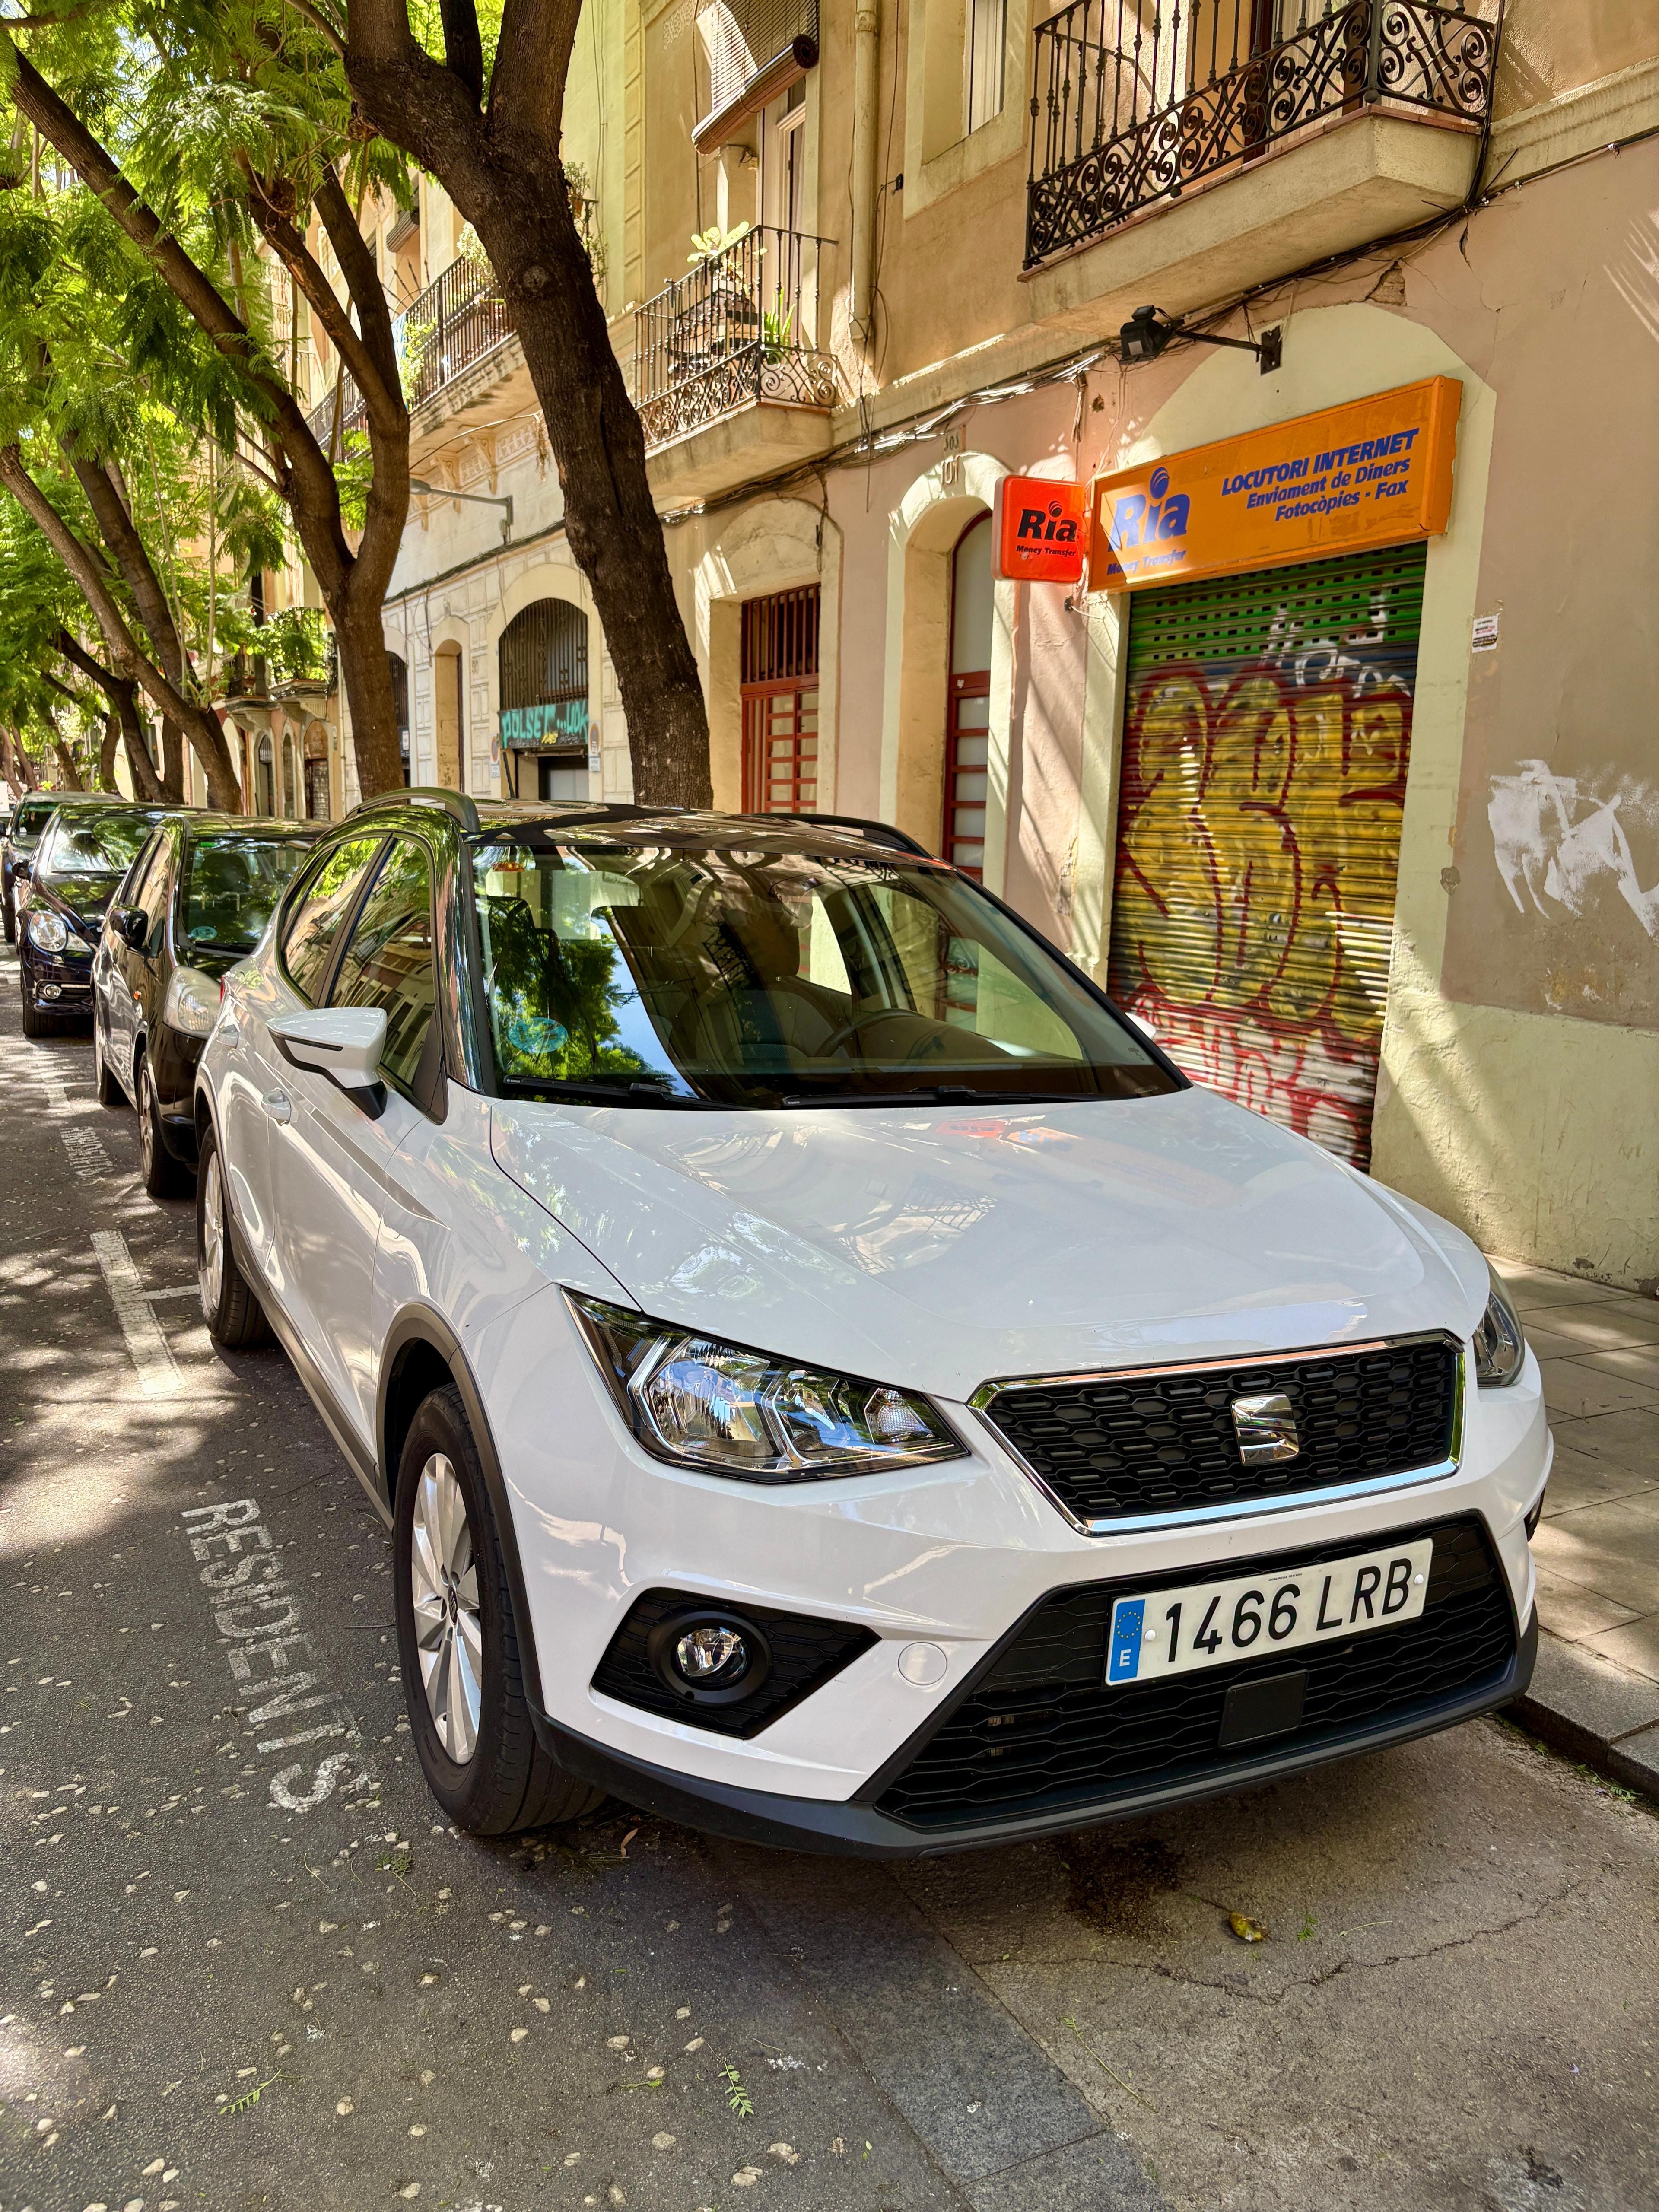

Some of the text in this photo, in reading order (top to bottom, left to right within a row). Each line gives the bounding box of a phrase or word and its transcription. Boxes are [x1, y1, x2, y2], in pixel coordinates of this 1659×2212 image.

[1221, 428, 1420, 496] LOCUTORI INTERNET
[1246, 458, 1411, 509] Enviament de Diners
[1017, 500, 1077, 542] Ria
[1108, 467, 1190, 553] Ria
[1275, 489, 1360, 522] Fotocòpies
[1375, 480, 1410, 499] Fax
[1016, 545, 1077, 558] Money Transfer
[1107, 549, 1187, 575] Money Transfer
[1119, 1558, 1412, 1668] E 1466 LRB
[181, 1497, 371, 1812] RESIDENTS
